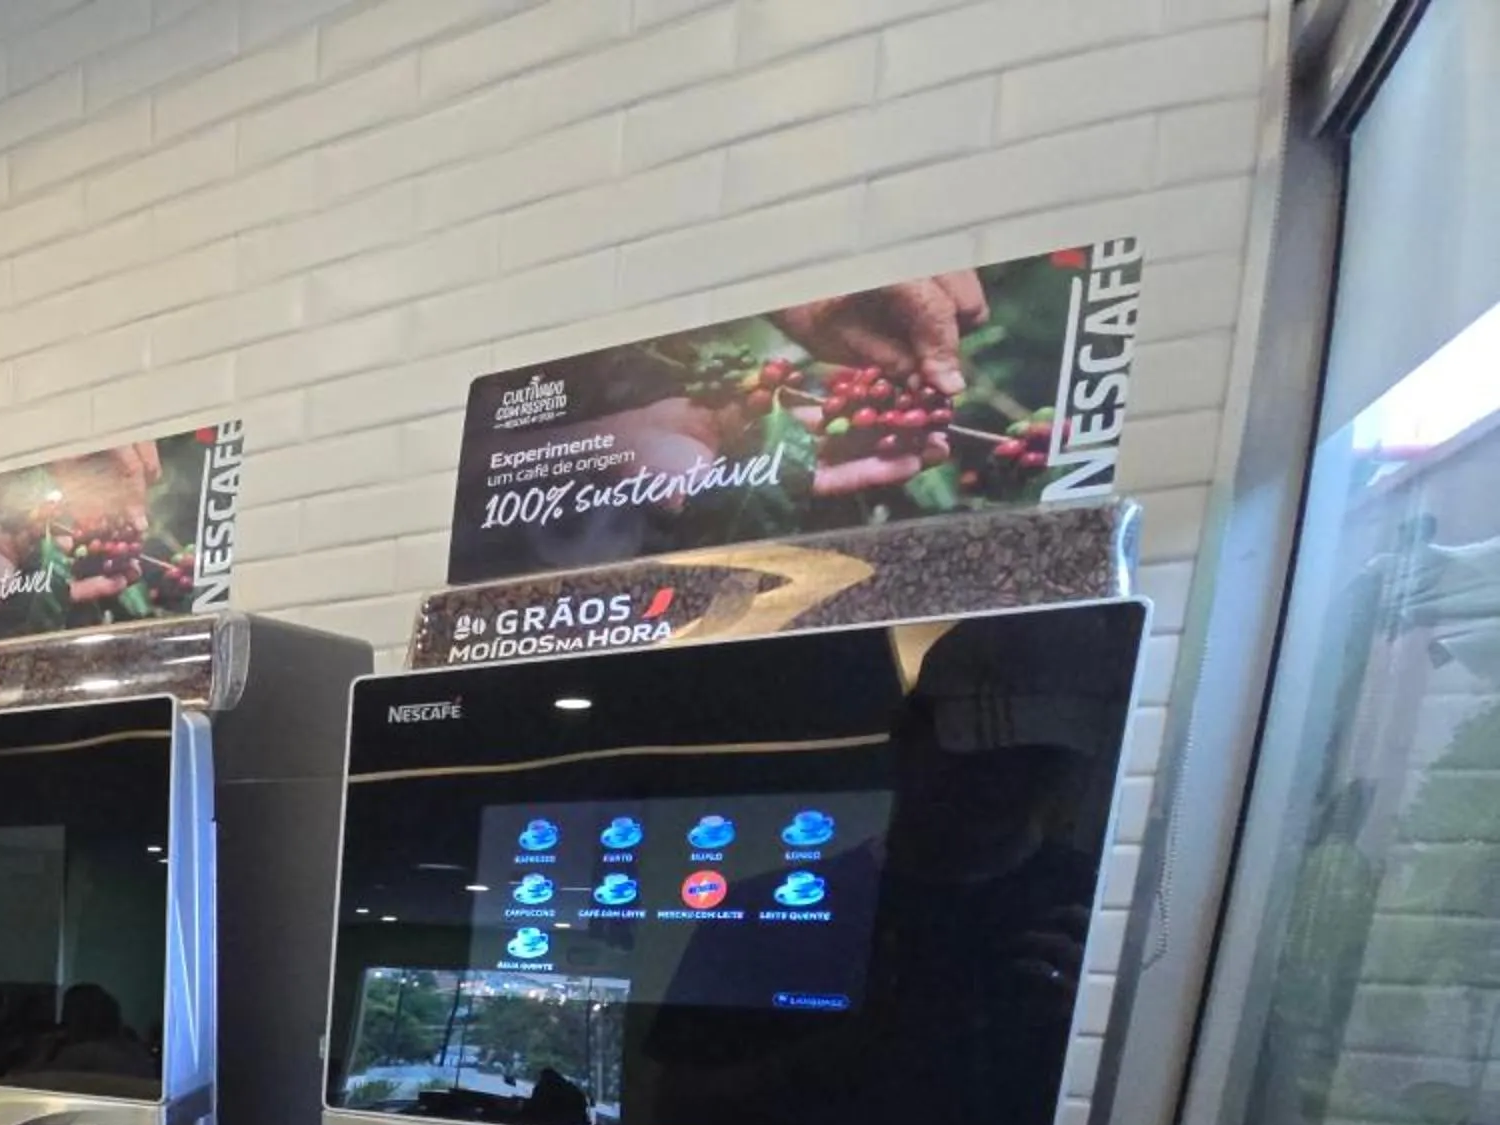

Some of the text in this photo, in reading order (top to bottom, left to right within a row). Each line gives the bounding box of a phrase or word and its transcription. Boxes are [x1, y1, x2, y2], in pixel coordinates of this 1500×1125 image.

[487, 449, 636, 487] um café de origem
[490, 433, 615, 470] Experimente
[481, 441, 787, 530] 100% sustentável
[495, 593, 632, 636] GRÃOS
[448, 634, 555, 663] MOÍDOS
[586, 619, 674, 649] HORA
